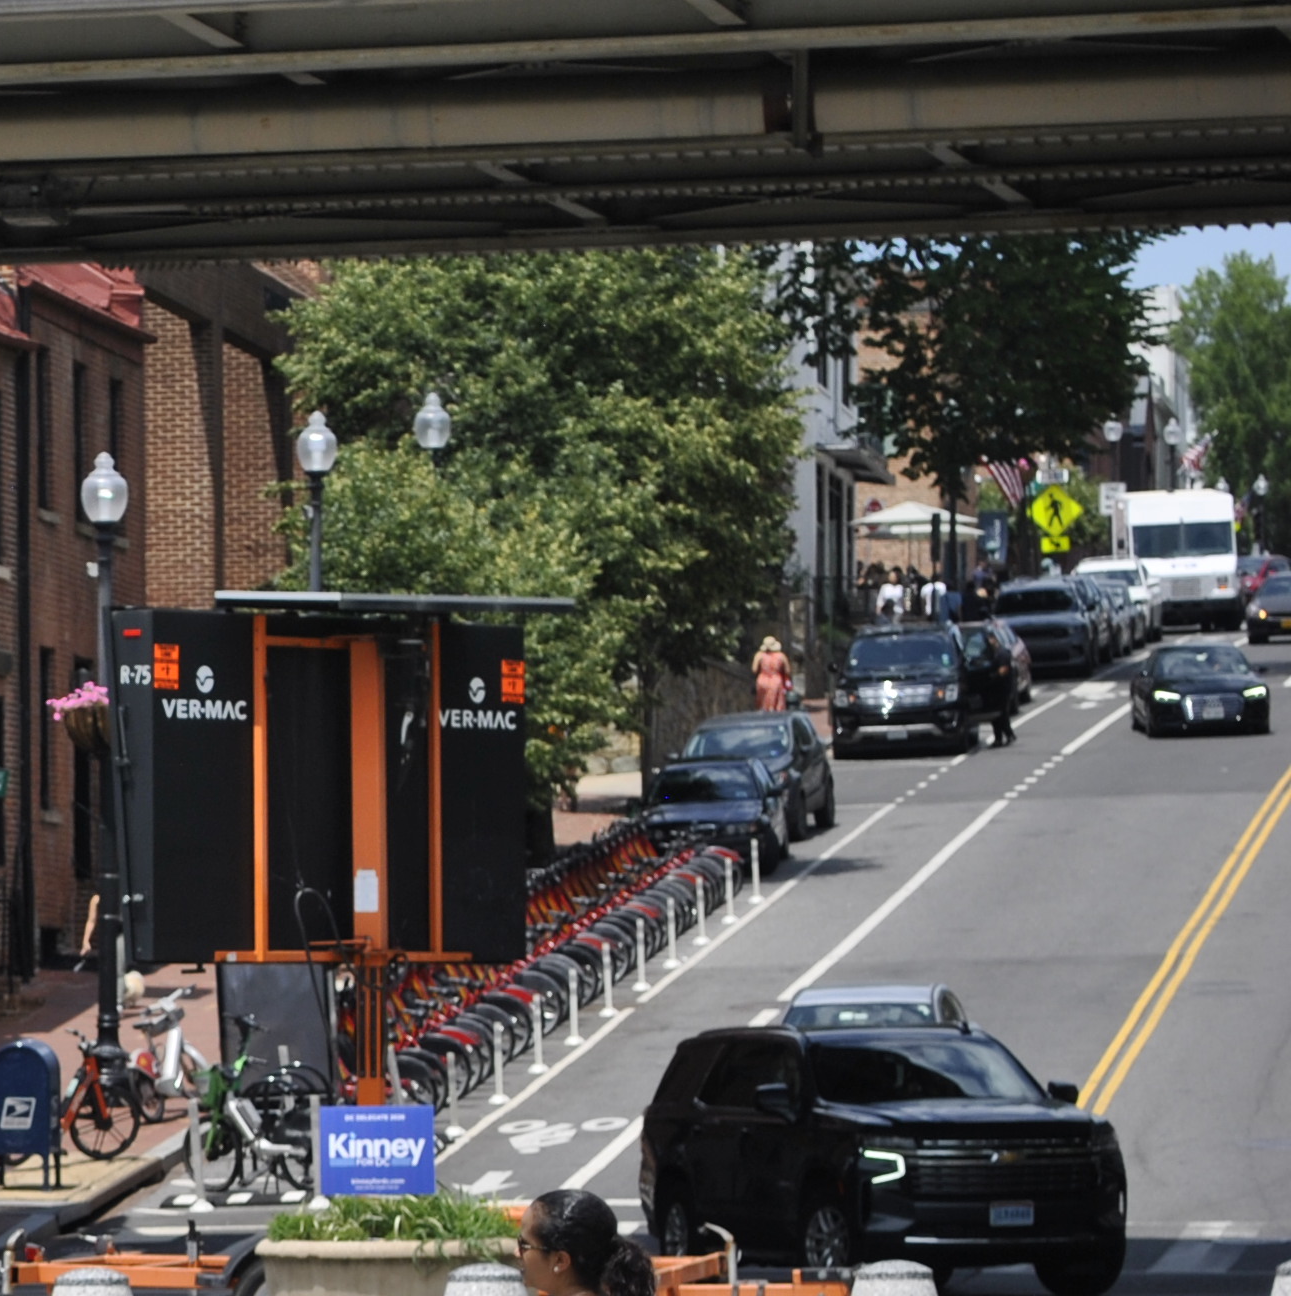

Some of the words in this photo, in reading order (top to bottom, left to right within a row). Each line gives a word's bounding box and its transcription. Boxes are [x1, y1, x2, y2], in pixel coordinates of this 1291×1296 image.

[356, 1113, 389, 1122] DELEGATE
[328, 1131, 426, 1167] Kinney
[355, 1157, 374, 1167] FOR
[375, 1157, 391, 1167] DC
